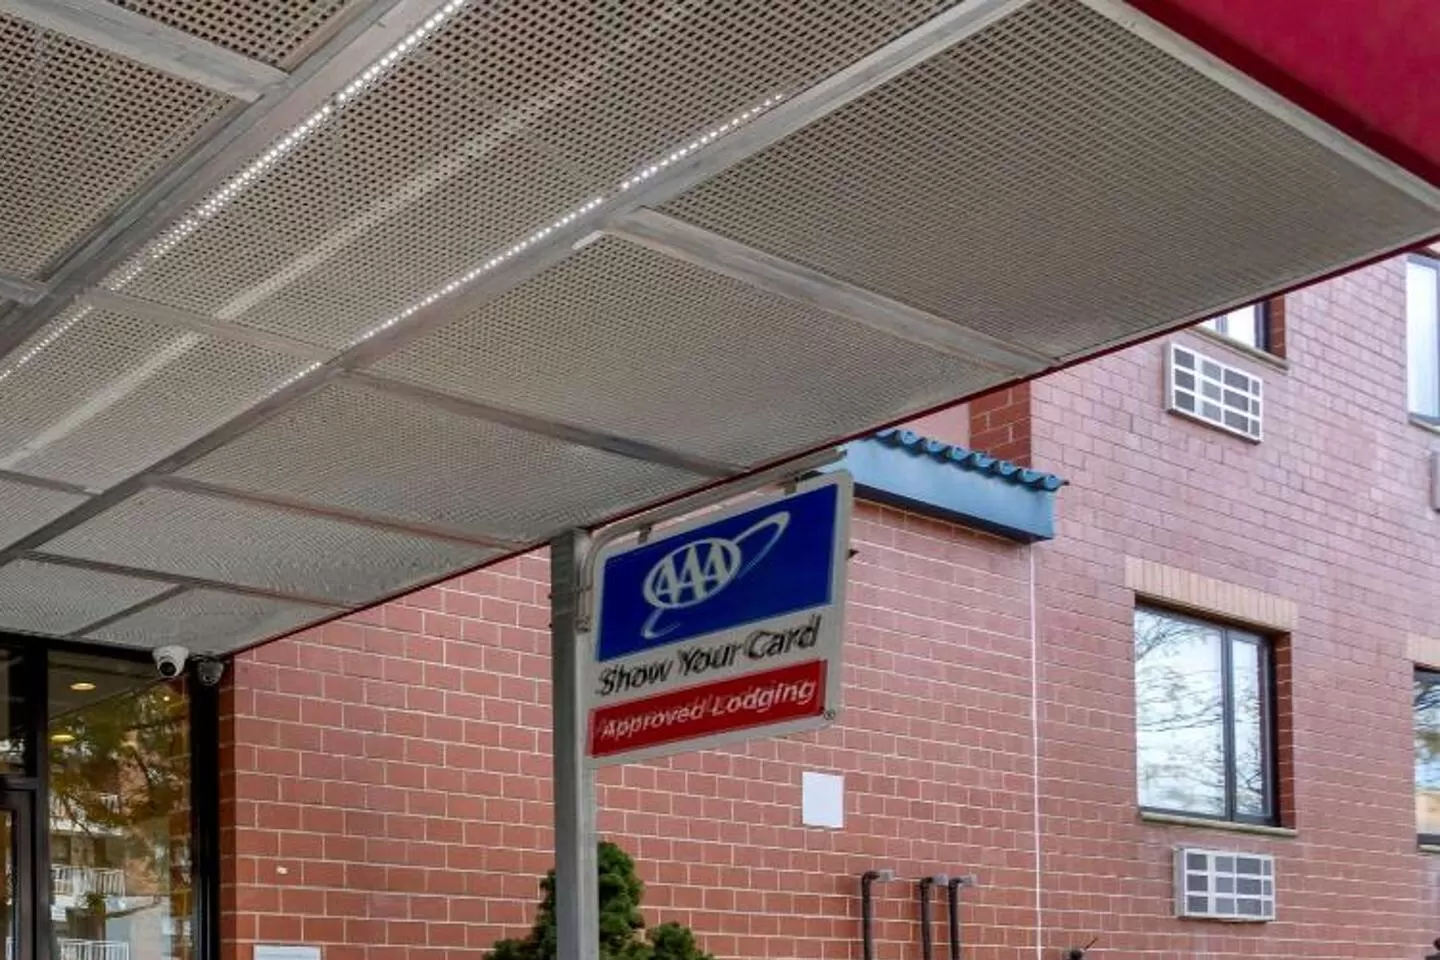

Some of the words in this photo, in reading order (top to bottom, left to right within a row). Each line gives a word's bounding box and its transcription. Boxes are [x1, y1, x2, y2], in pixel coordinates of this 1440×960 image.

[655, 541, 726, 604] AAA
[595, 658, 673, 697] Show
[678, 643, 744, 678] Your
[744, 614, 822, 661] Card
[599, 697, 706, 741] Approved
[710, 679, 817, 715] Lodging
